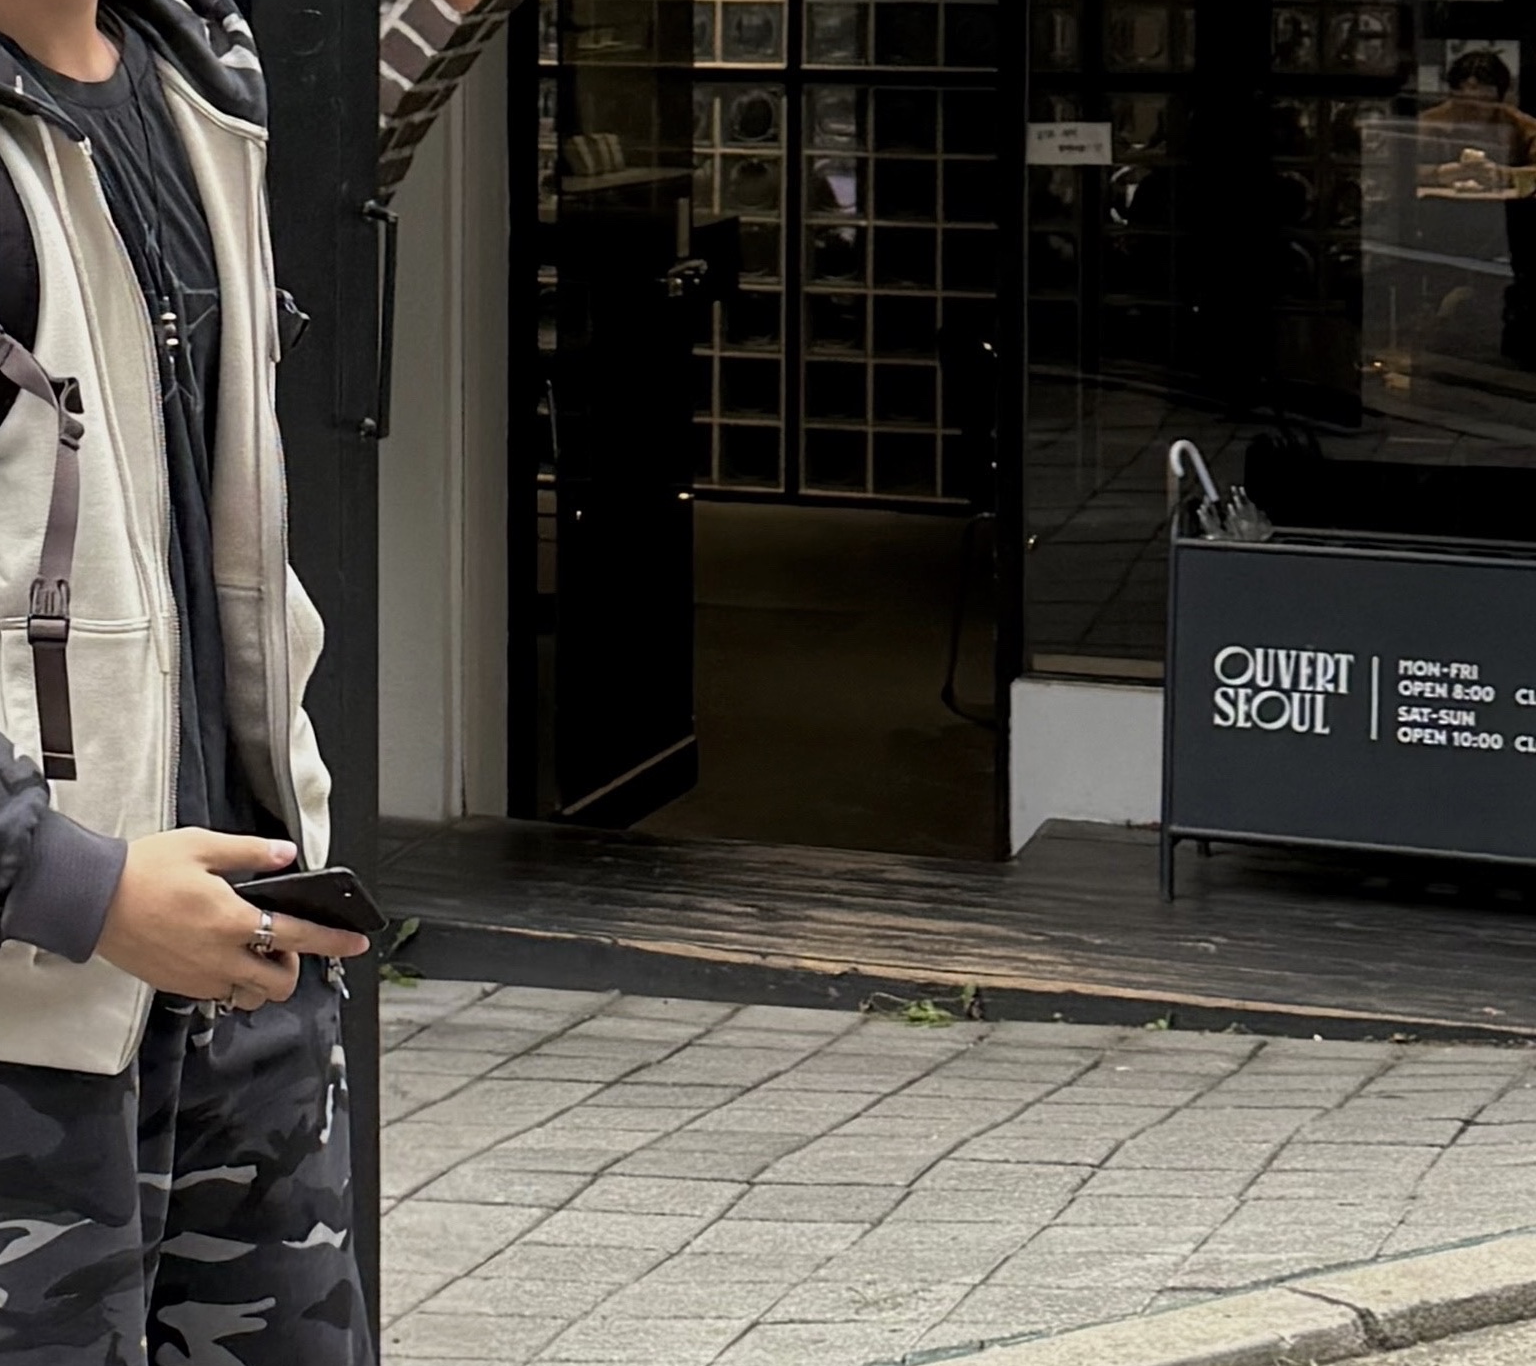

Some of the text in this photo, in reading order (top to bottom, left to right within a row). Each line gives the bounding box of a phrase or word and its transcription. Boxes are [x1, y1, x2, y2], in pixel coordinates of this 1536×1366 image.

[1214, 646, 1354, 694] OUVERT
[1398, 659, 1478, 680] MON-FRI
[1398, 680, 1448, 698] OPEN
[1452, 684, 1495, 702] 8:00
[1213, 686, 1330, 734] SEOUL
[1397, 706, 1476, 726] SAT-SUN
[1397, 726, 1447, 745] OPEN
[1452, 731, 1504, 750] 10:00
